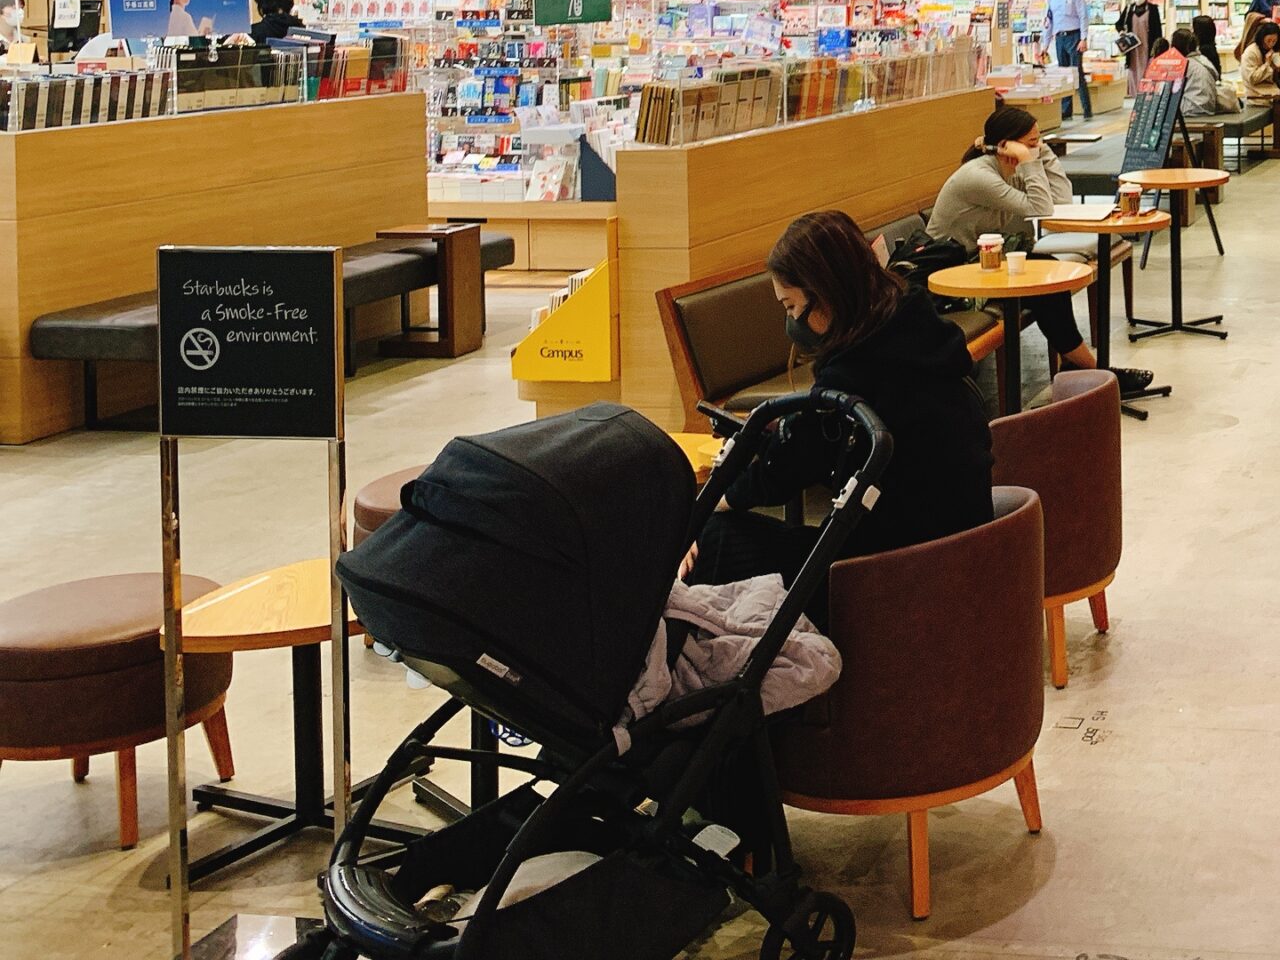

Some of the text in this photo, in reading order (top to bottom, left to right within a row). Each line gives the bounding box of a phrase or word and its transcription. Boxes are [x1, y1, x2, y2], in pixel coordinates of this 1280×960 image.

[183, 278, 274, 296] Starbucks is
[201, 308, 212, 321] a
[540, 347, 583, 360] Campus
